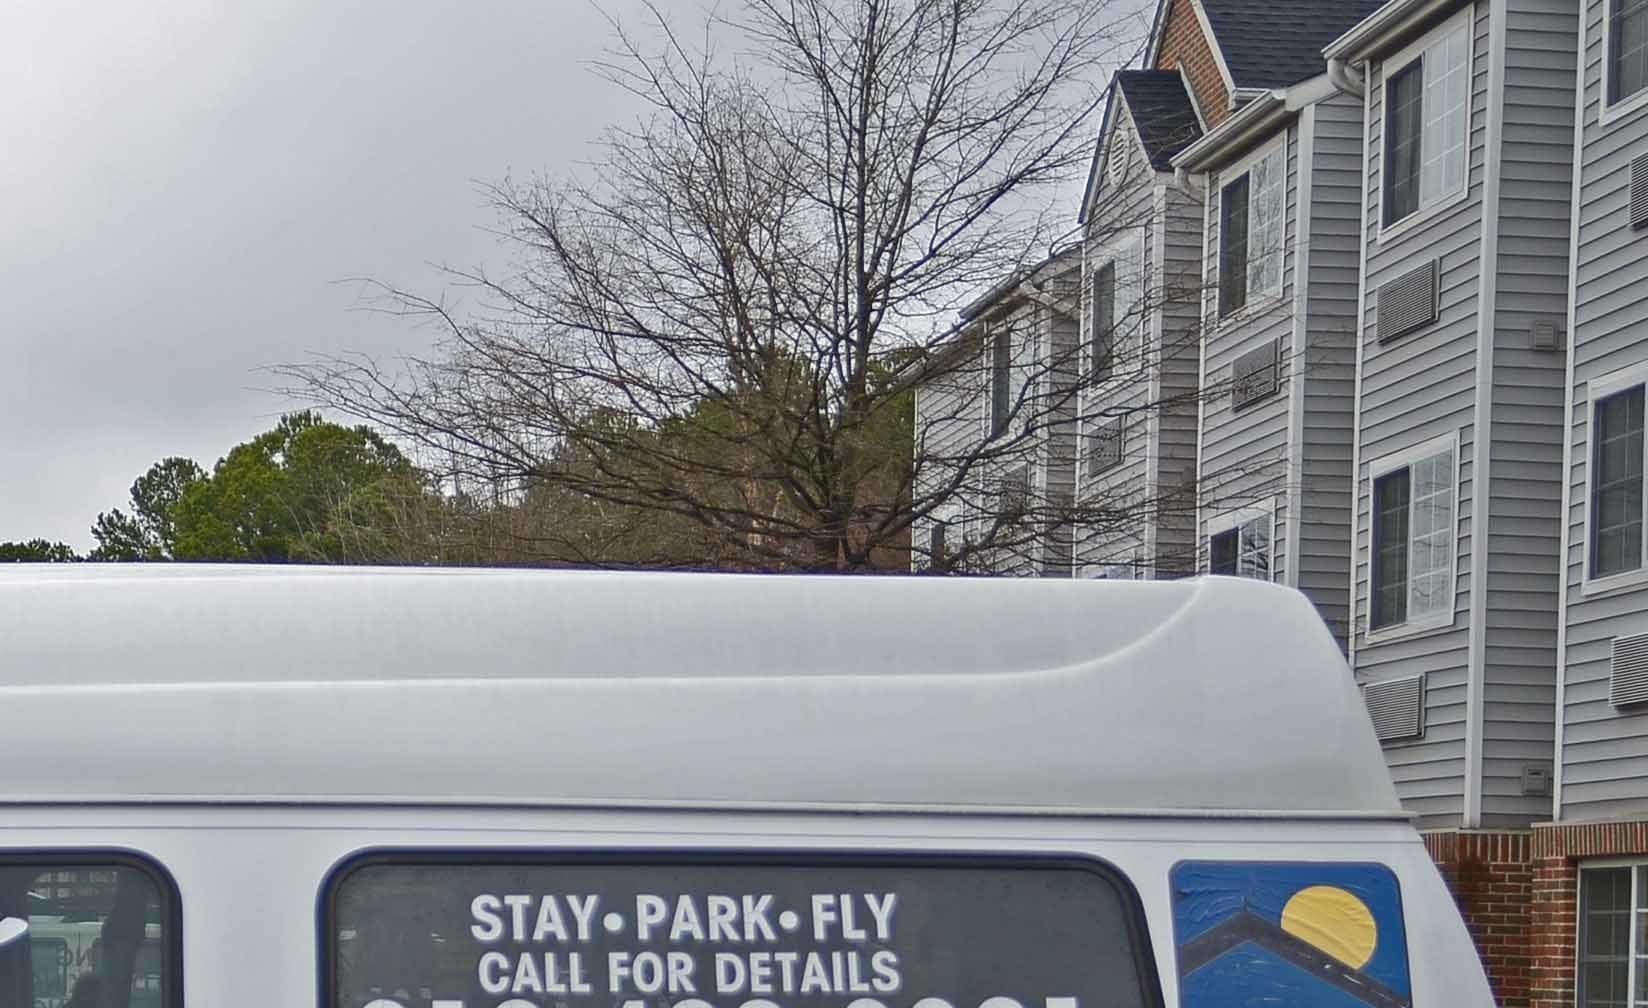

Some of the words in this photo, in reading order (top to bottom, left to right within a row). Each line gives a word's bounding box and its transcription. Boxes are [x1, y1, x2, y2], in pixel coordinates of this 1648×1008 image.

[812, 893, 898, 939] FLY
[478, 951, 591, 993] CALL
[608, 951, 696, 993] FOR
[715, 950, 901, 993] DETAILS
